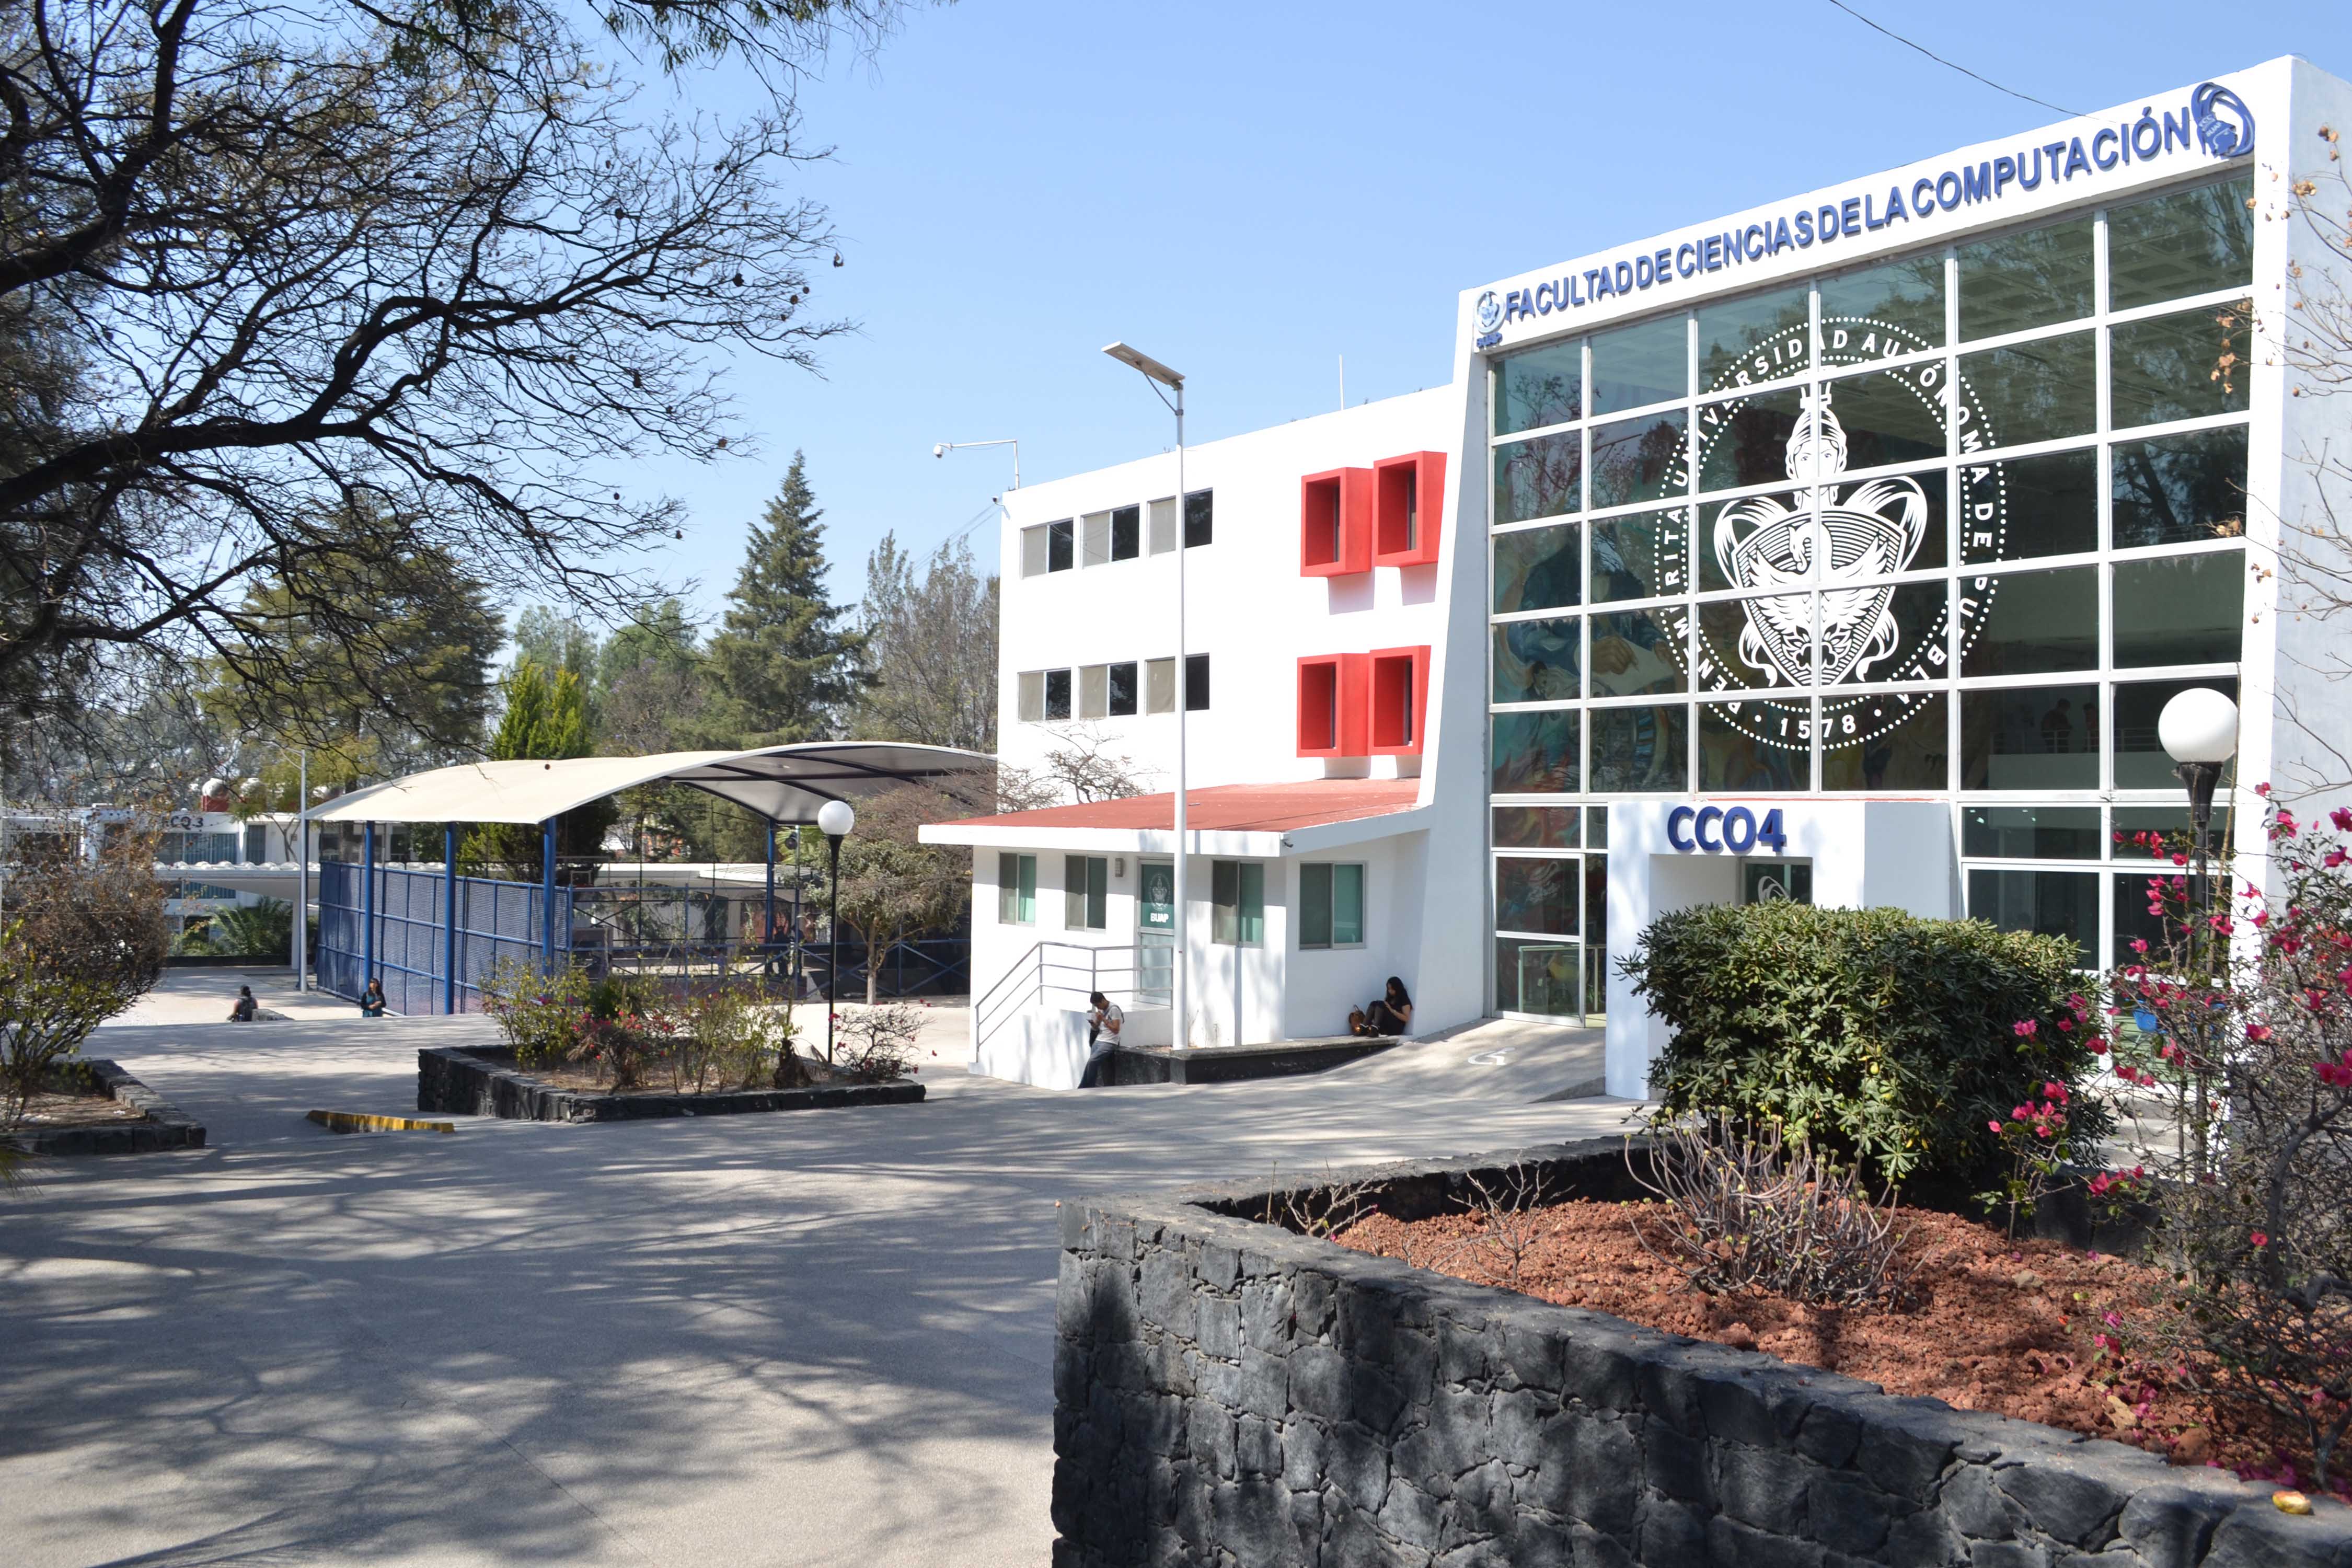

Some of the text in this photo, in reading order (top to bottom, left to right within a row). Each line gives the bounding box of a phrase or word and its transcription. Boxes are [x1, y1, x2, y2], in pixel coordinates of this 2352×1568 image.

[1505, 106, 2190, 325] FACULTAD DE CIENCIAS DE LA COMPUTACIÓN
[1664, 509, 1742, 714] BENMRITA
[1973, 503, 1993, 547] DE
[1780, 714, 1856, 739] 1578
